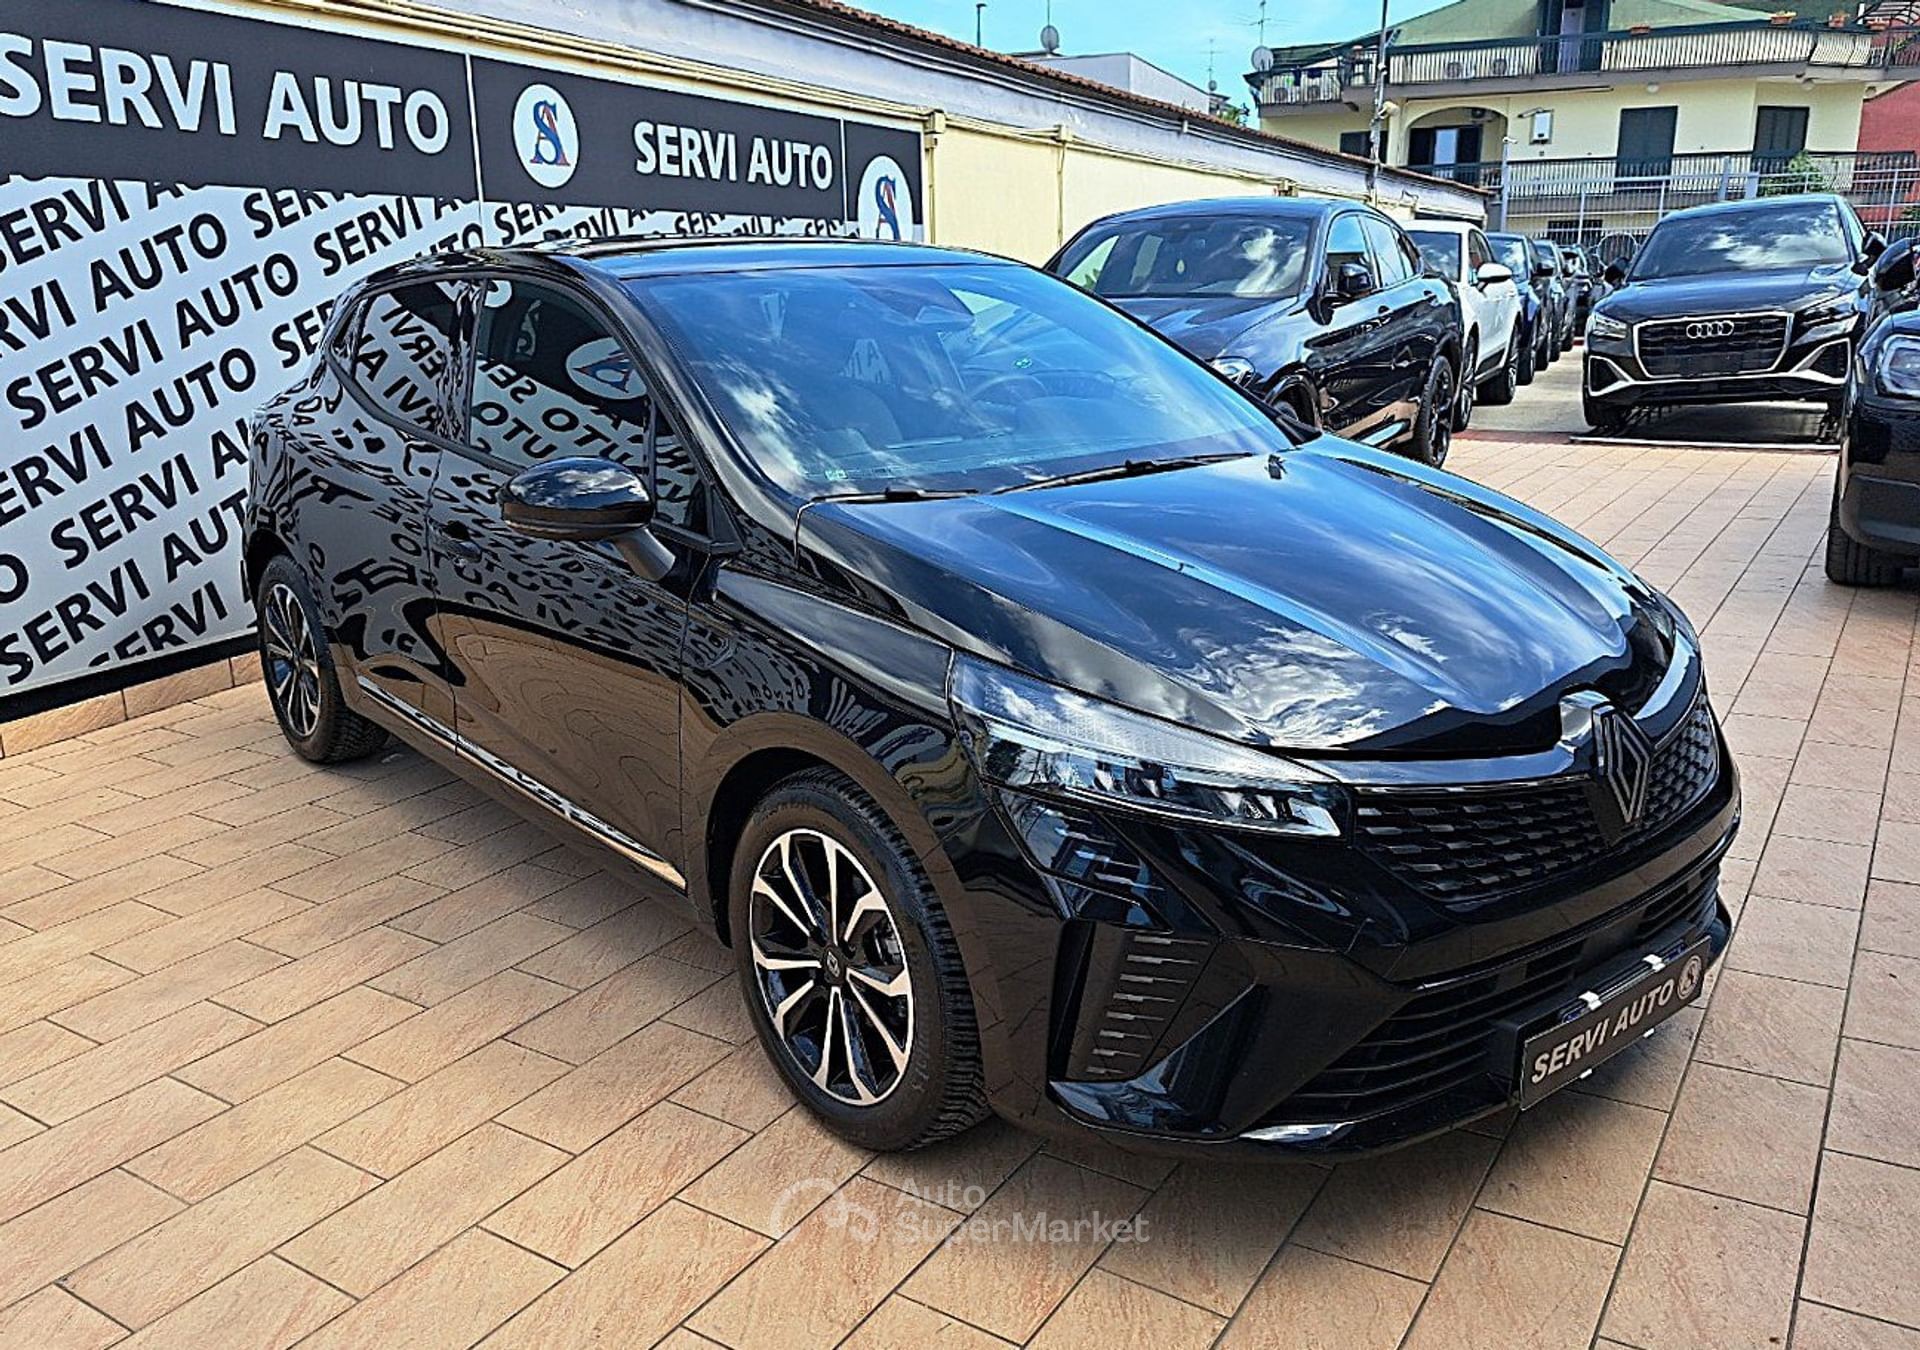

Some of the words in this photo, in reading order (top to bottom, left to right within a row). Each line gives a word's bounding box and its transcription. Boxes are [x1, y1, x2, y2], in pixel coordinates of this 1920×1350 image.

[0, 32, 237, 136] SERVI
[263, 71, 450, 154] AUTO
[633, 121, 737, 181] SERVI
[747, 137, 833, 190] AUTO
[0, 179, 130, 273] ERVI
[0, 279, 77, 352] RVI
[90, 213, 227, 313] AUTO
[6, 319, 164, 430] SERVI
[176, 253, 298, 350] AUTO
[314, 196, 423, 276] SERVI
[0, 424, 113, 528] ERVI
[126, 348, 256, 453] AUTO
[51, 453, 199, 570] SERVI
[0, 558, 150, 685] SERVI
[163, 488, 249, 583] AUT
[1531, 1018, 1610, 1084] SERVI
[1612, 979, 1675, 1037] AUTO
